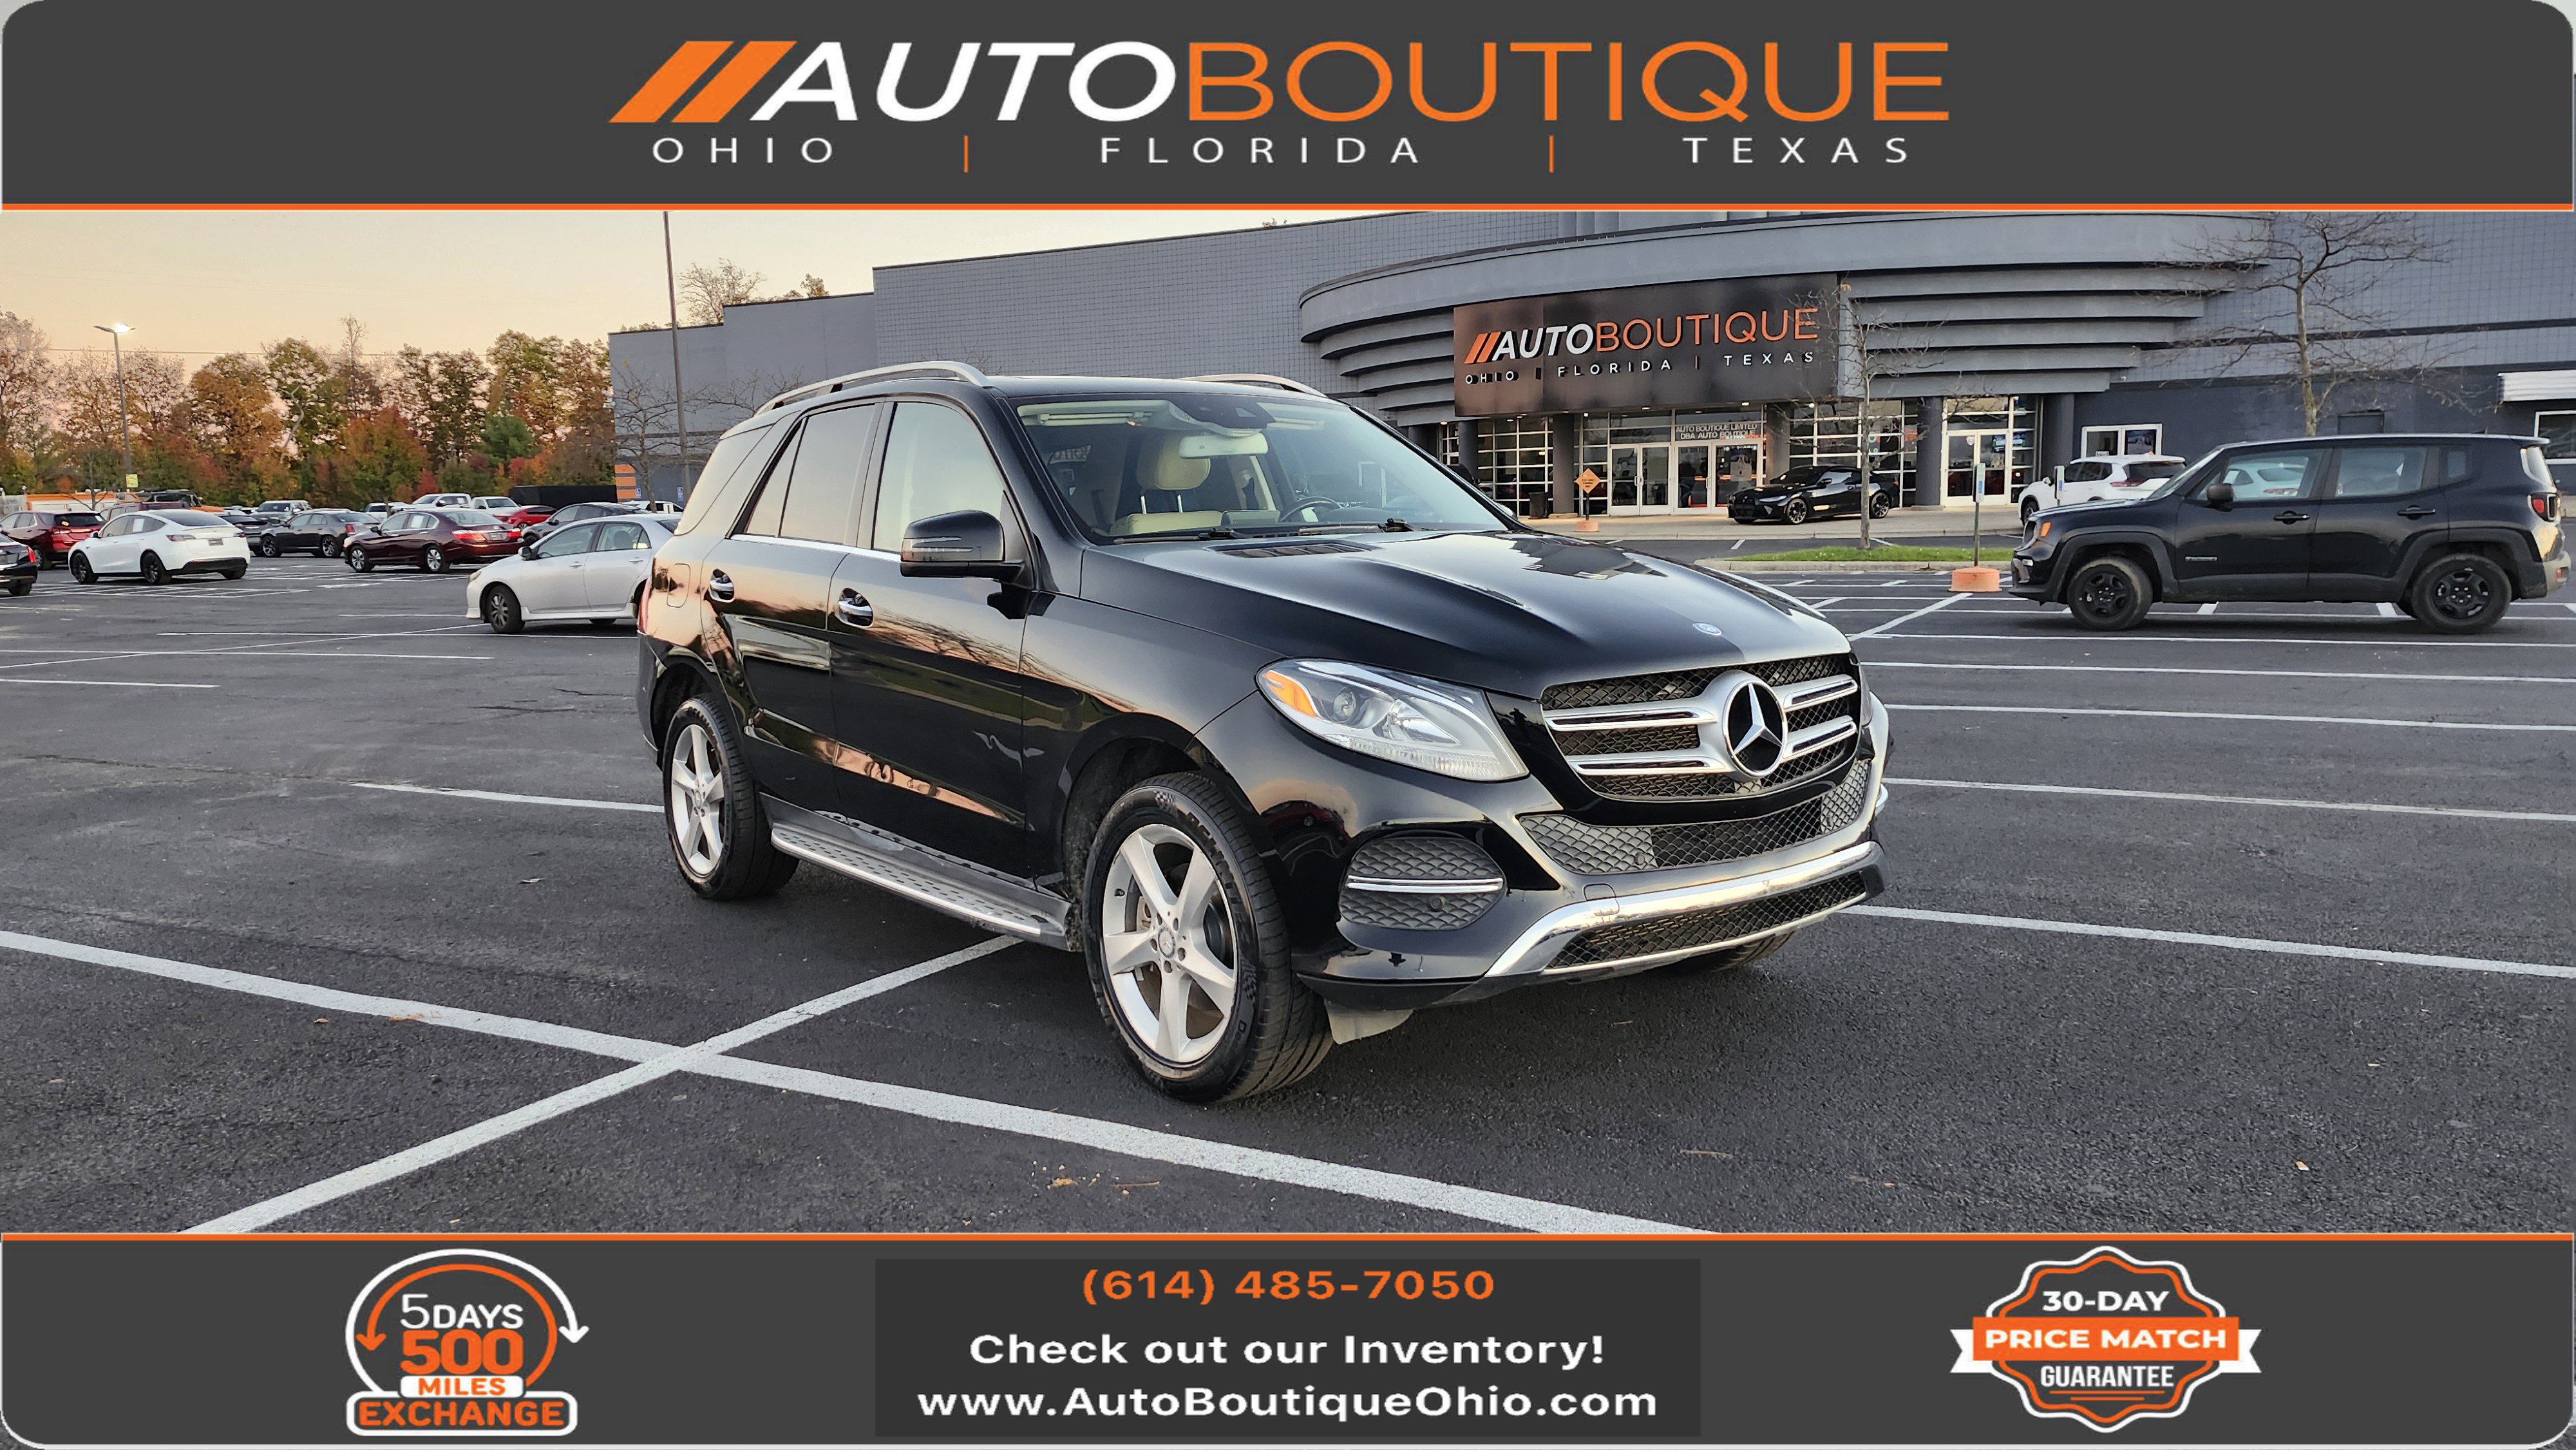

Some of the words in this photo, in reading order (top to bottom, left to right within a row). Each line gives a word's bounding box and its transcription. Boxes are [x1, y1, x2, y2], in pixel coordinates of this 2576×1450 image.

[1465, 370, 1515, 385] OHIO
[1557, 359, 1671, 377] FLORIDA
[1723, 351, 1814, 367] TEXAS
[1696, 424, 1730, 432] BOUTIQUE
